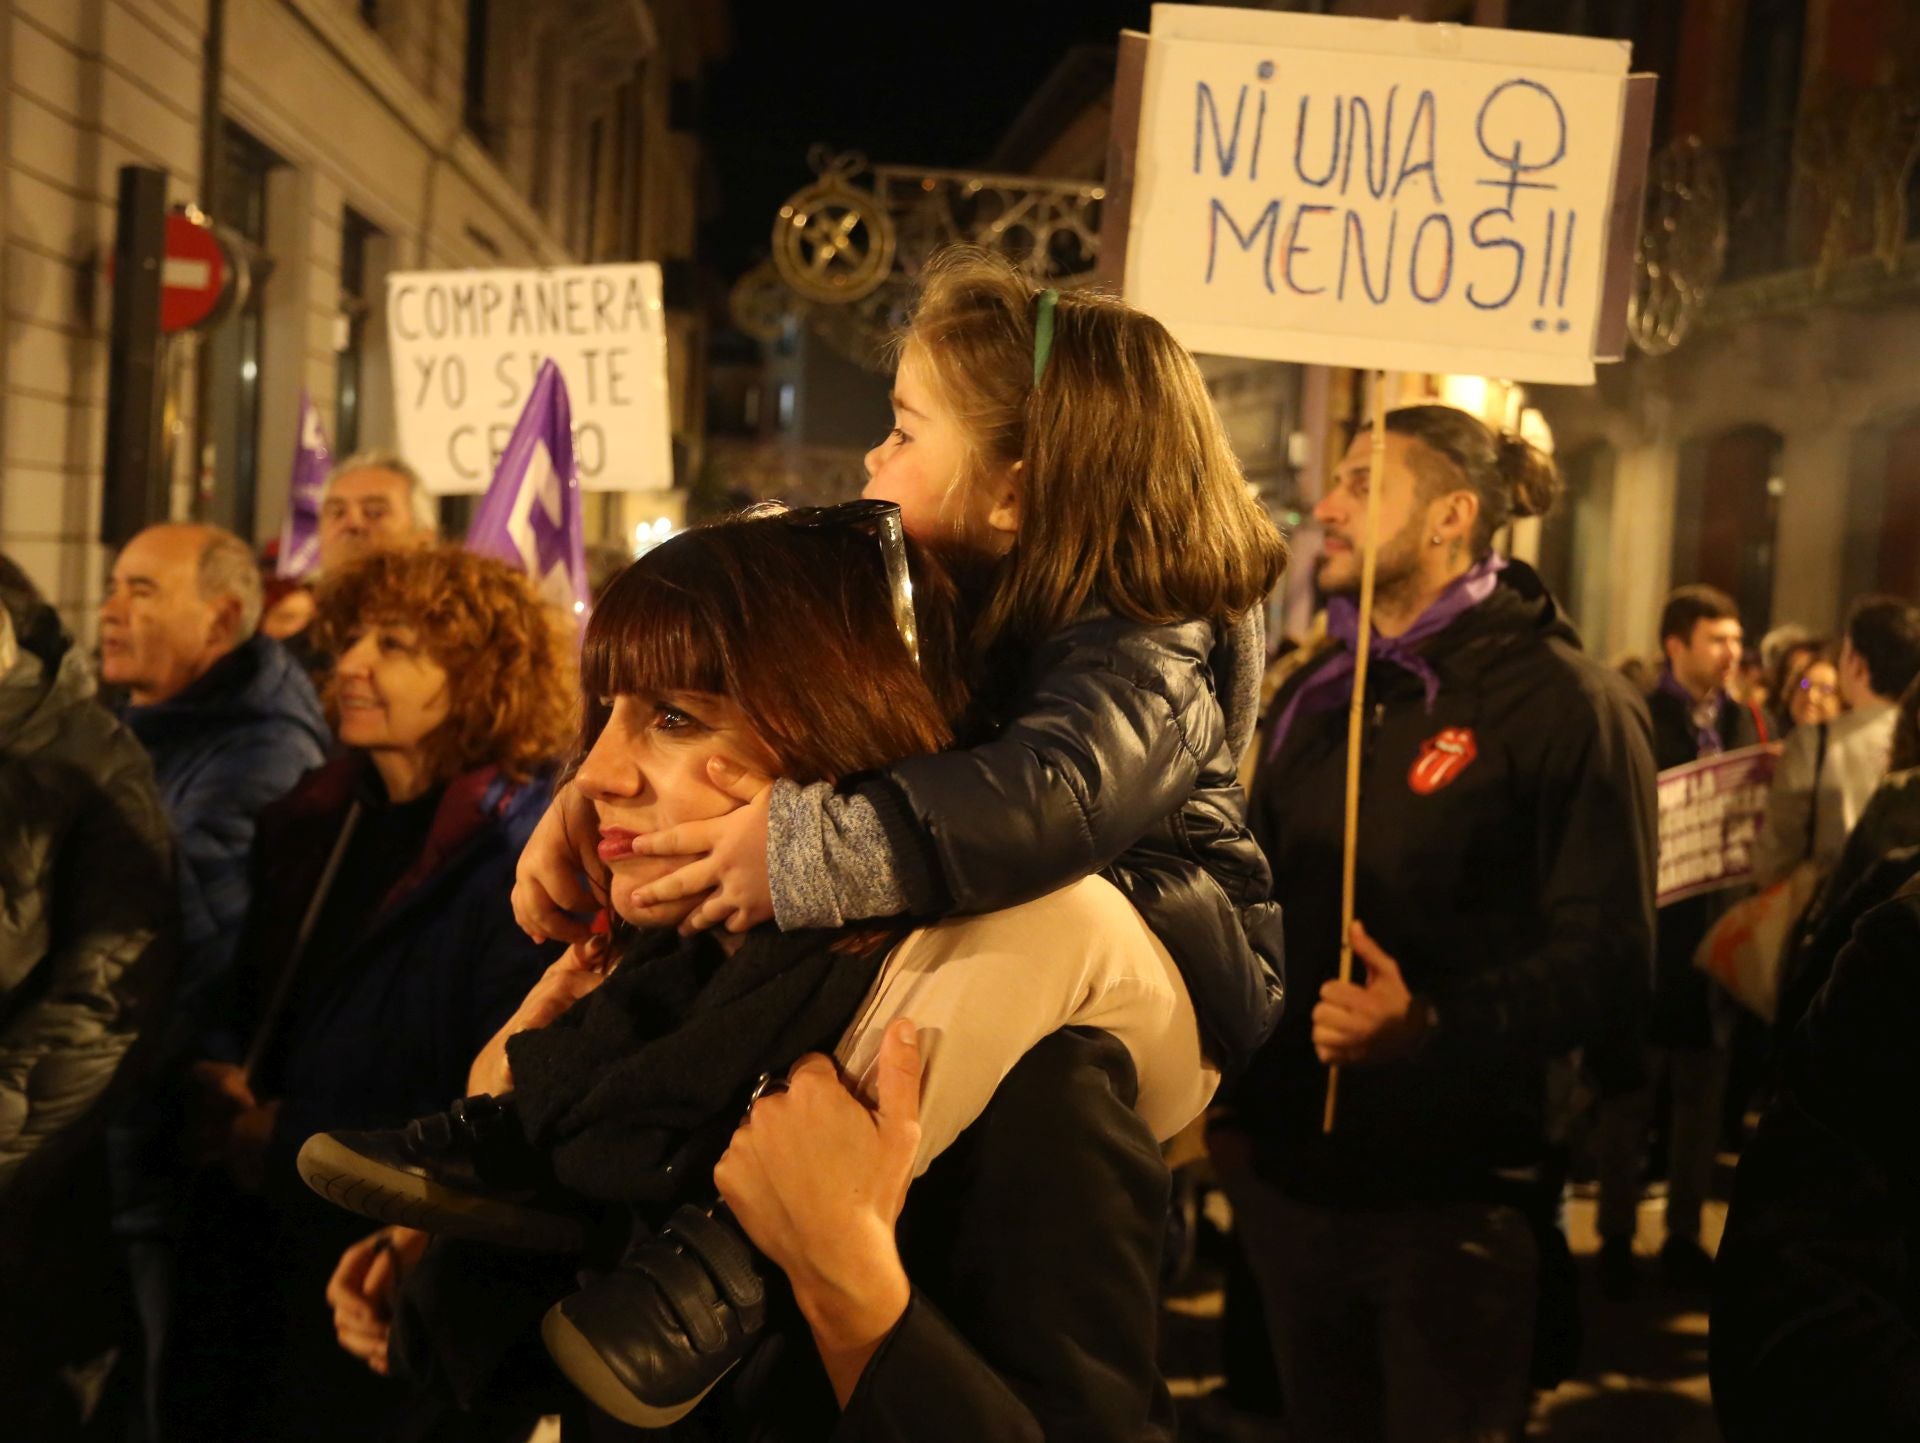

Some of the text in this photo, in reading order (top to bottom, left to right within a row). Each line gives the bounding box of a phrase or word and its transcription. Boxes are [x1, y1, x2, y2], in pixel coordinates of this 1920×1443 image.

[1293, 84, 1444, 203] UNA
[1205, 197, 1577, 333] MENOS!!
[412, 352, 468, 412] YO
[580, 347, 634, 407] TE
[448, 421, 607, 480] CO
